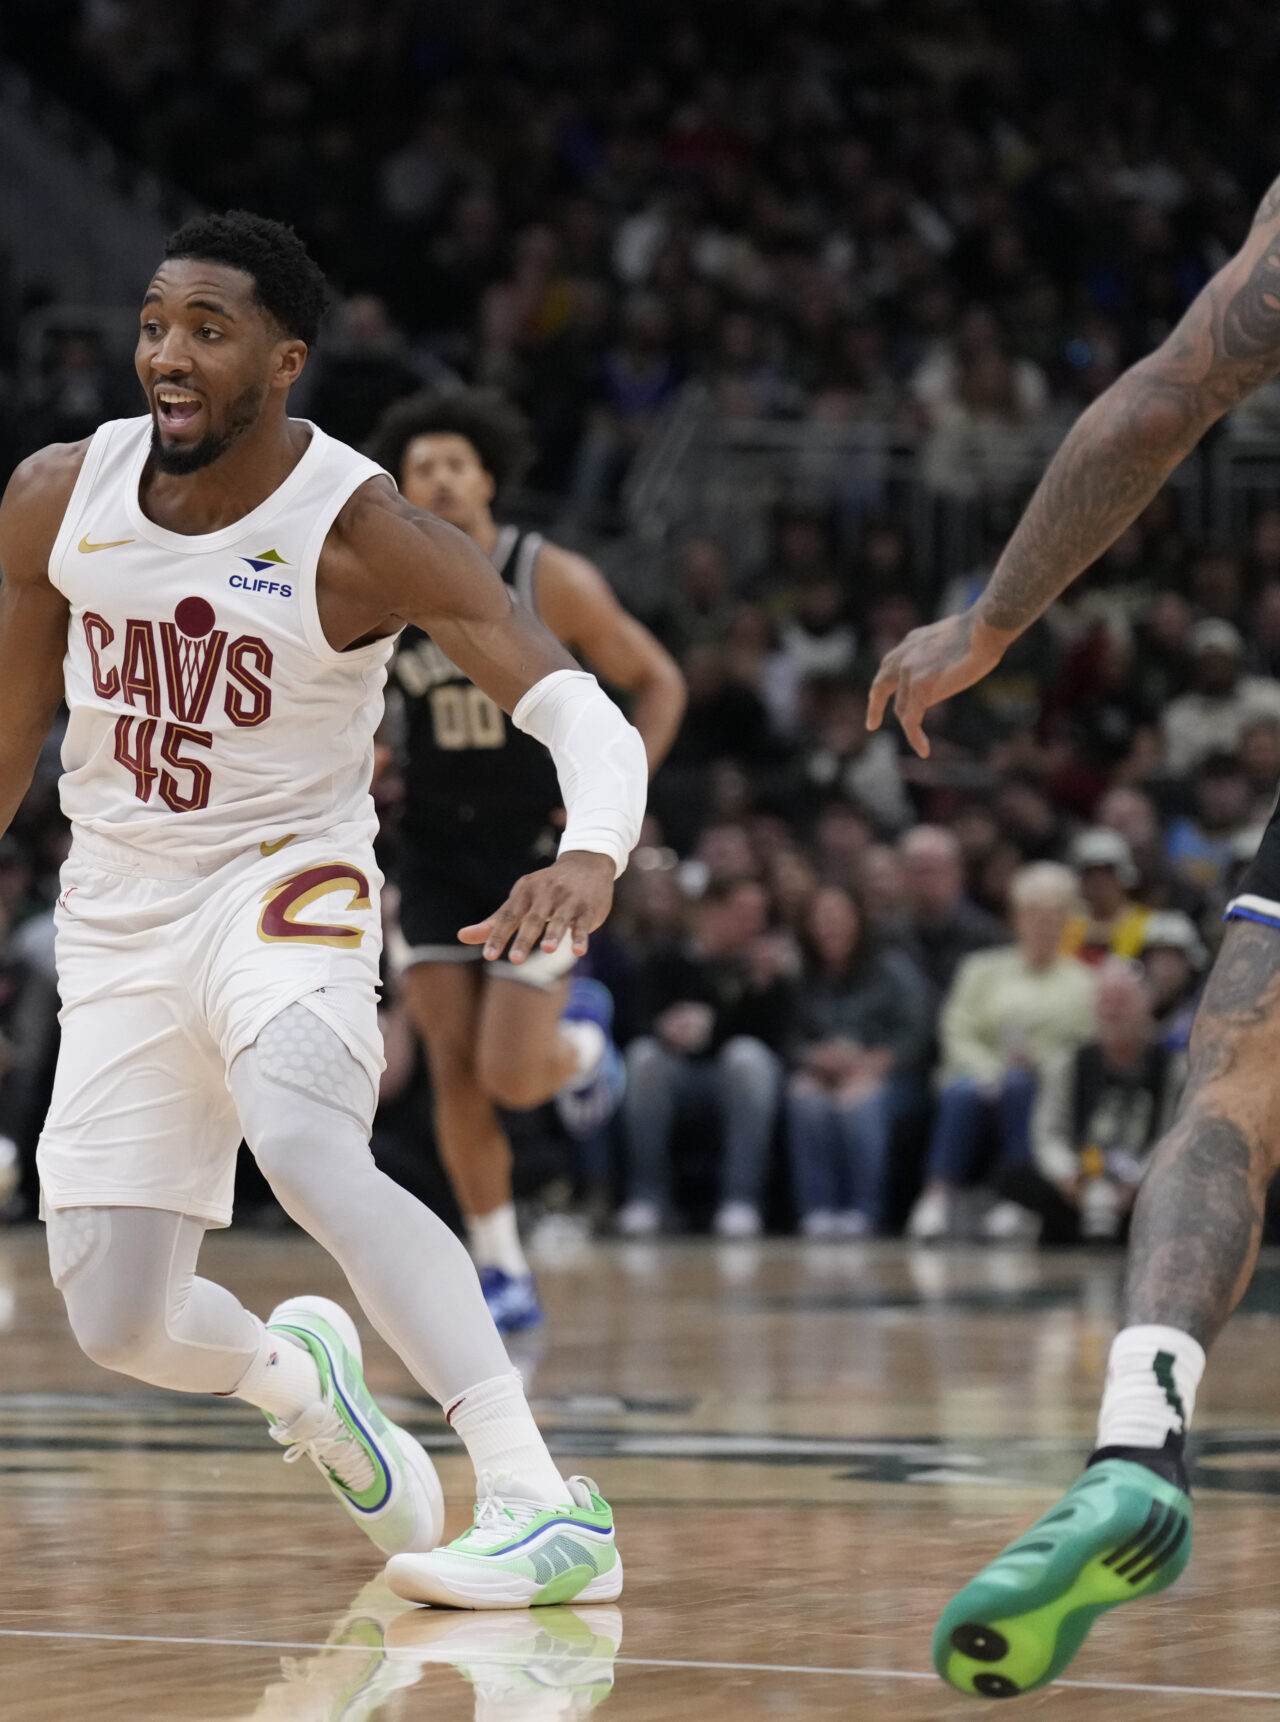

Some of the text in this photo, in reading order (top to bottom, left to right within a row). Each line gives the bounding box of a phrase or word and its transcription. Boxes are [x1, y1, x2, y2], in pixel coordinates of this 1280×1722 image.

[228, 574, 293, 598] CLIFFS
[81, 611, 274, 728] CAVS
[431, 684, 507, 750] 00
[114, 714, 213, 814] 45
